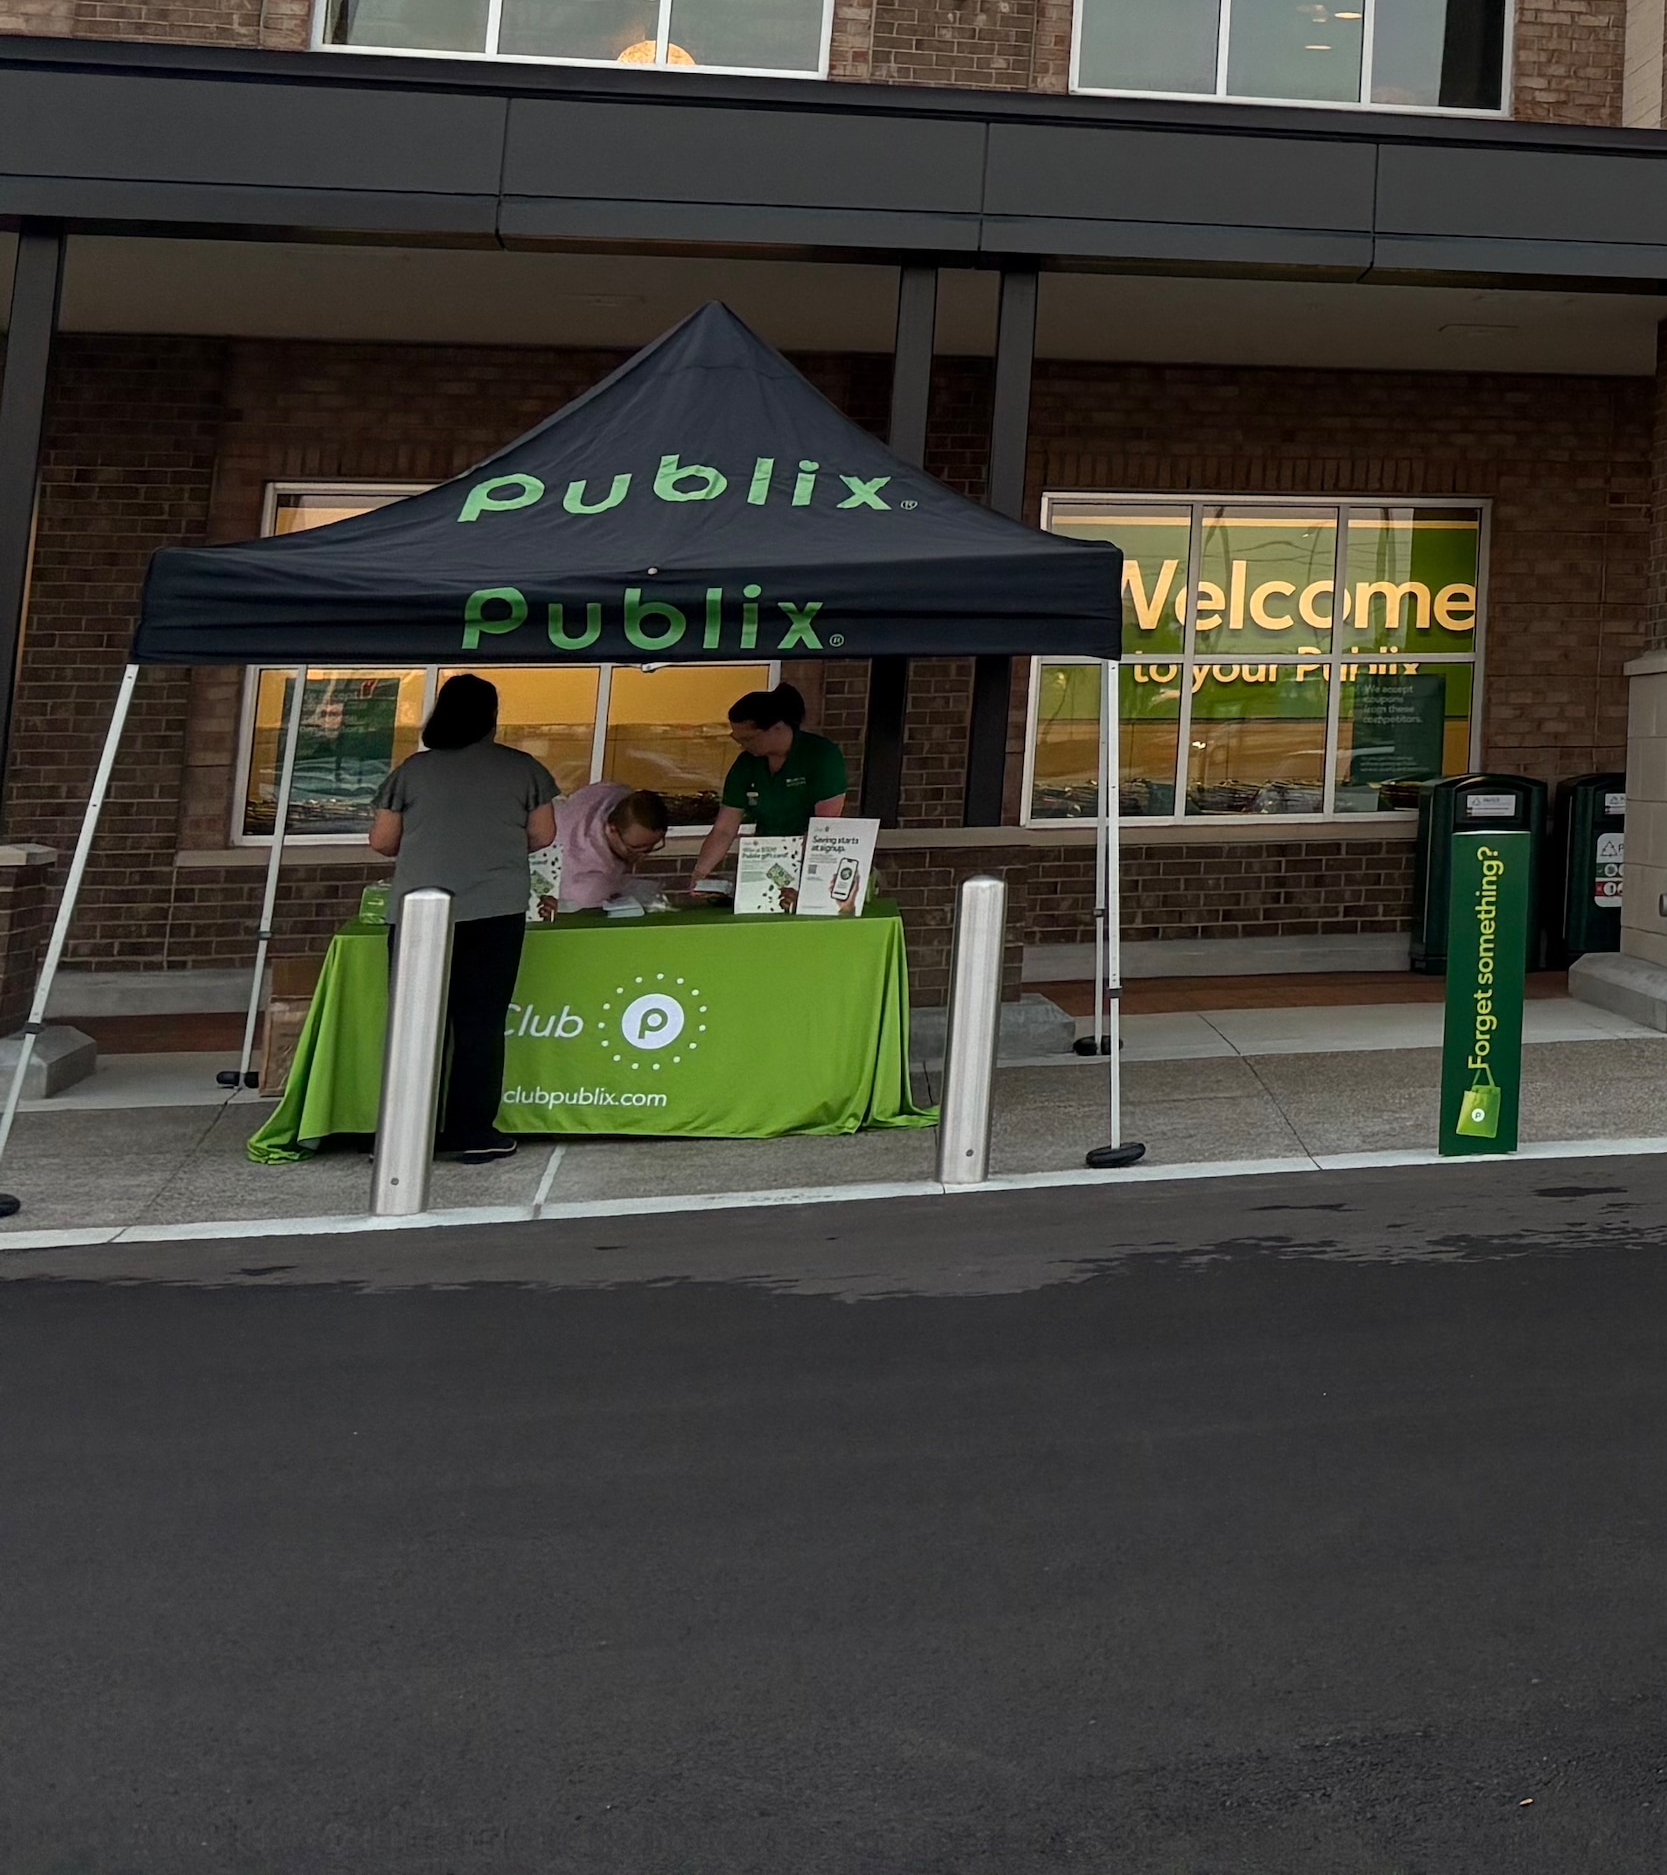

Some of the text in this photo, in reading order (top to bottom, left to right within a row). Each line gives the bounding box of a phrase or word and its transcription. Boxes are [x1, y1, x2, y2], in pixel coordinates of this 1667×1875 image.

[1473, 845, 1505, 986] something?
[1467, 989, 1498, 1069] Forget
[503, 1085, 668, 1110] clubpublix.com
